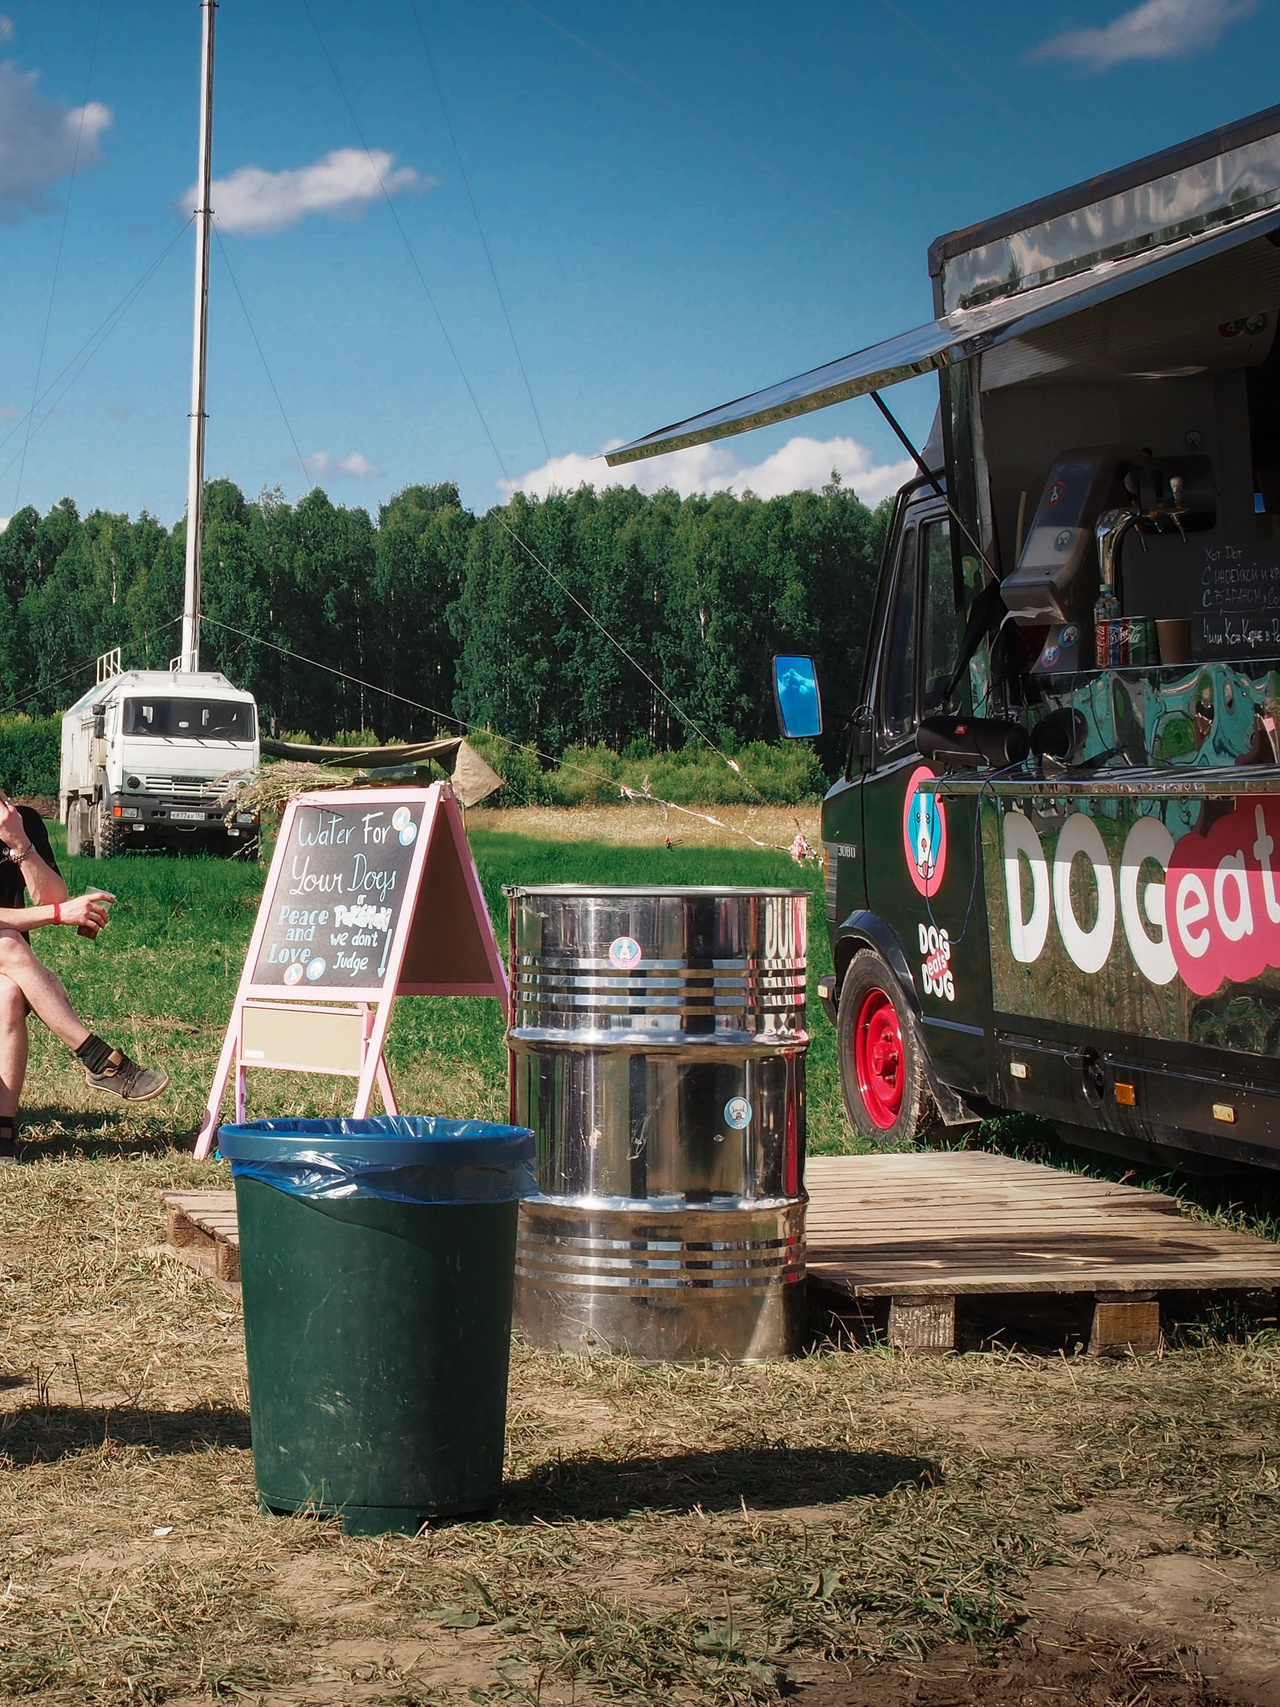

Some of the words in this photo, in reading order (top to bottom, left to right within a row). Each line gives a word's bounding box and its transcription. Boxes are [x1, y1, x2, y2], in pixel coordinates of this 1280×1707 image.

[298, 813, 356, 846] Water
[361, 811, 391, 844] For
[289, 855, 343, 895] Your
[347, 853, 396, 902] Dogs
[1003, 811, 1178, 985] DOG
[277, 905, 329, 925] Peace
[285, 926, 316, 941] and
[330, 932, 348, 946] we
[351, 928, 378, 947] don't
[918, 923, 951, 960] DOG
[268, 943, 311, 963] Love
[332, 951, 369, 977] Judge
[927, 951, 947, 976] eats
[921, 963, 955, 1002] DOG
